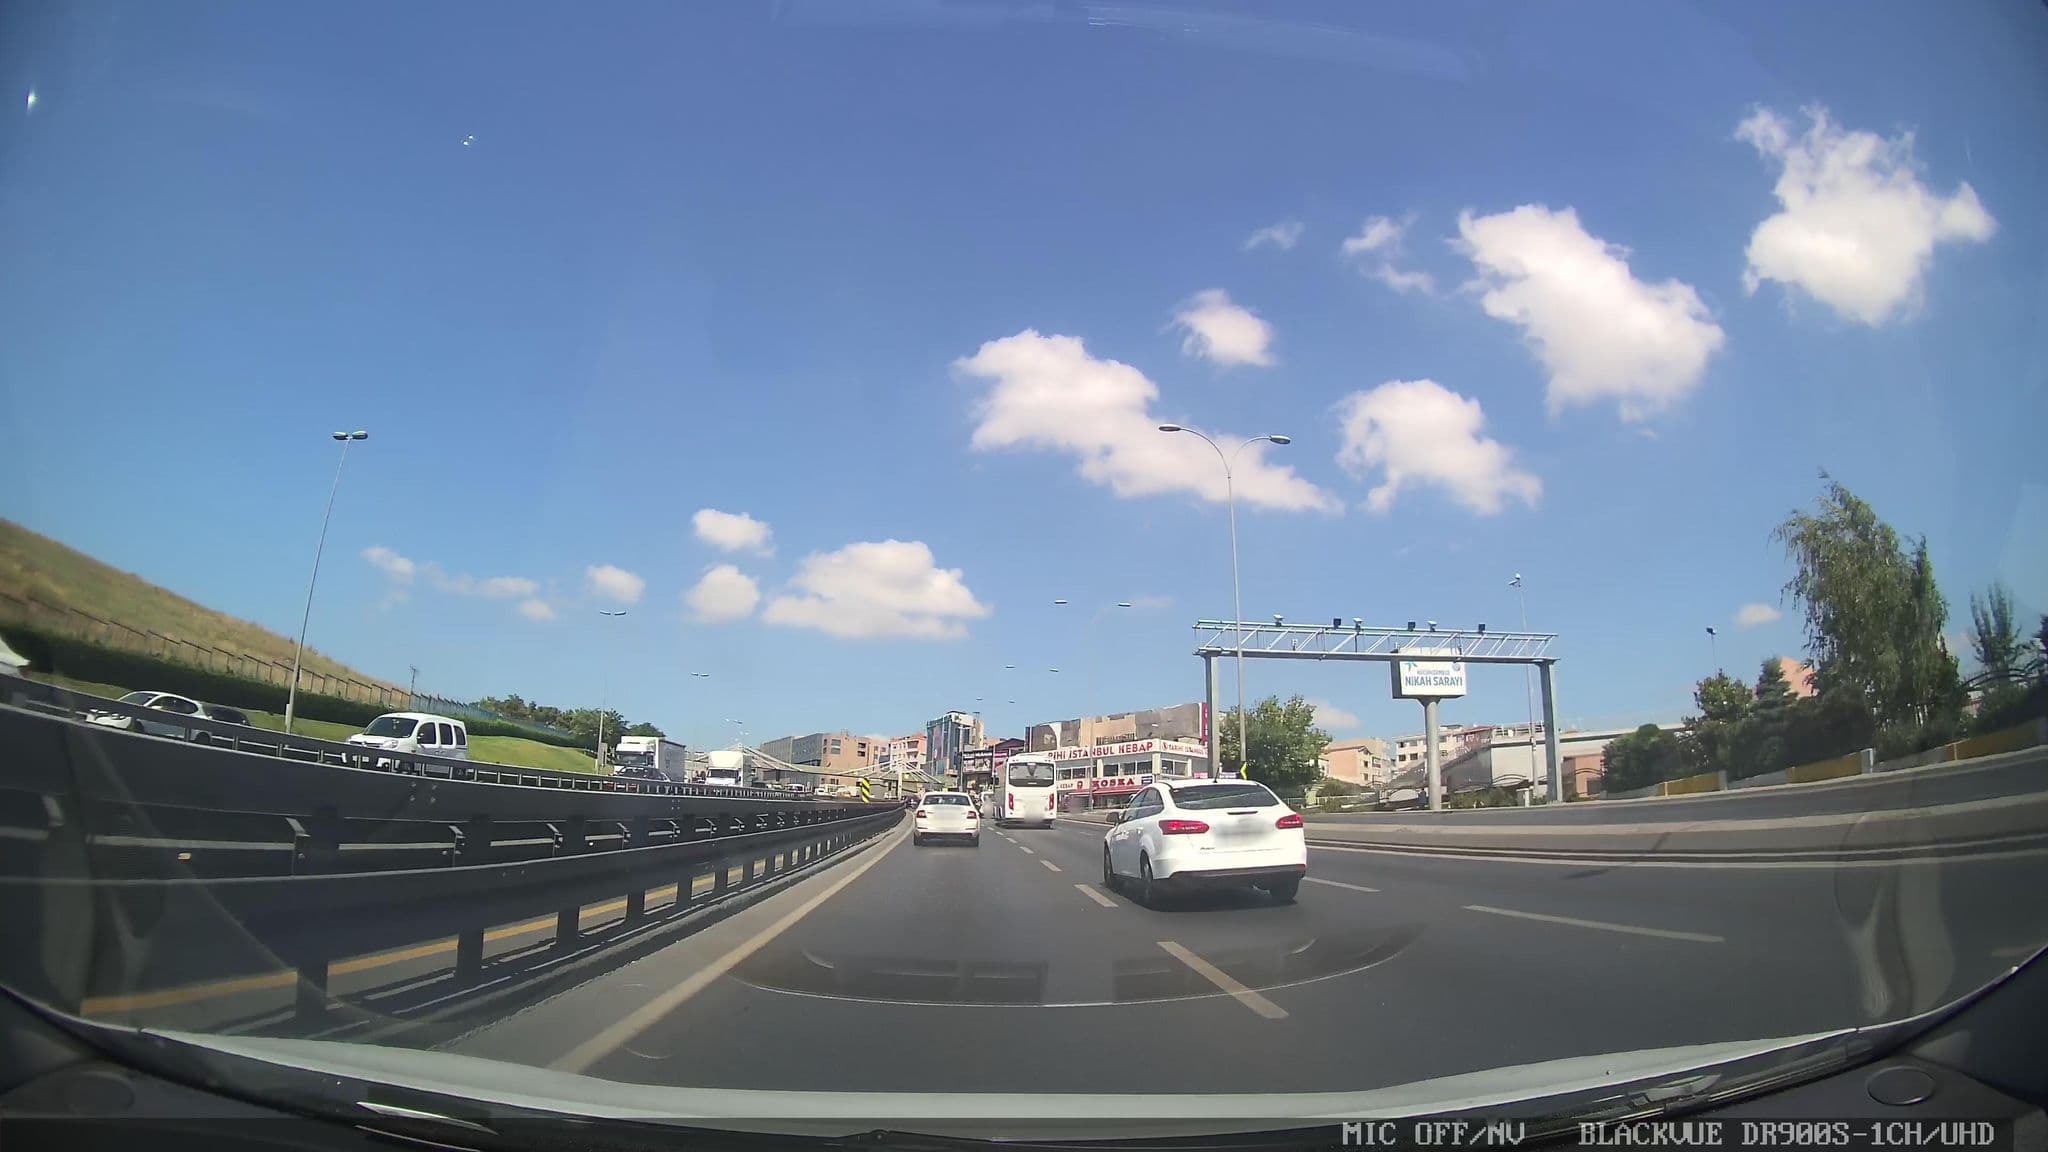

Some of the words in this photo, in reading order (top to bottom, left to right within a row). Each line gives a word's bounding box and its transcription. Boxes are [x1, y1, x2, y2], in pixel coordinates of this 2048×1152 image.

[1433, 676, 1463, 686] SARAYI
[1118, 741, 1153, 754] KEBAP
[1092, 778, 1135, 788] KOSKA
